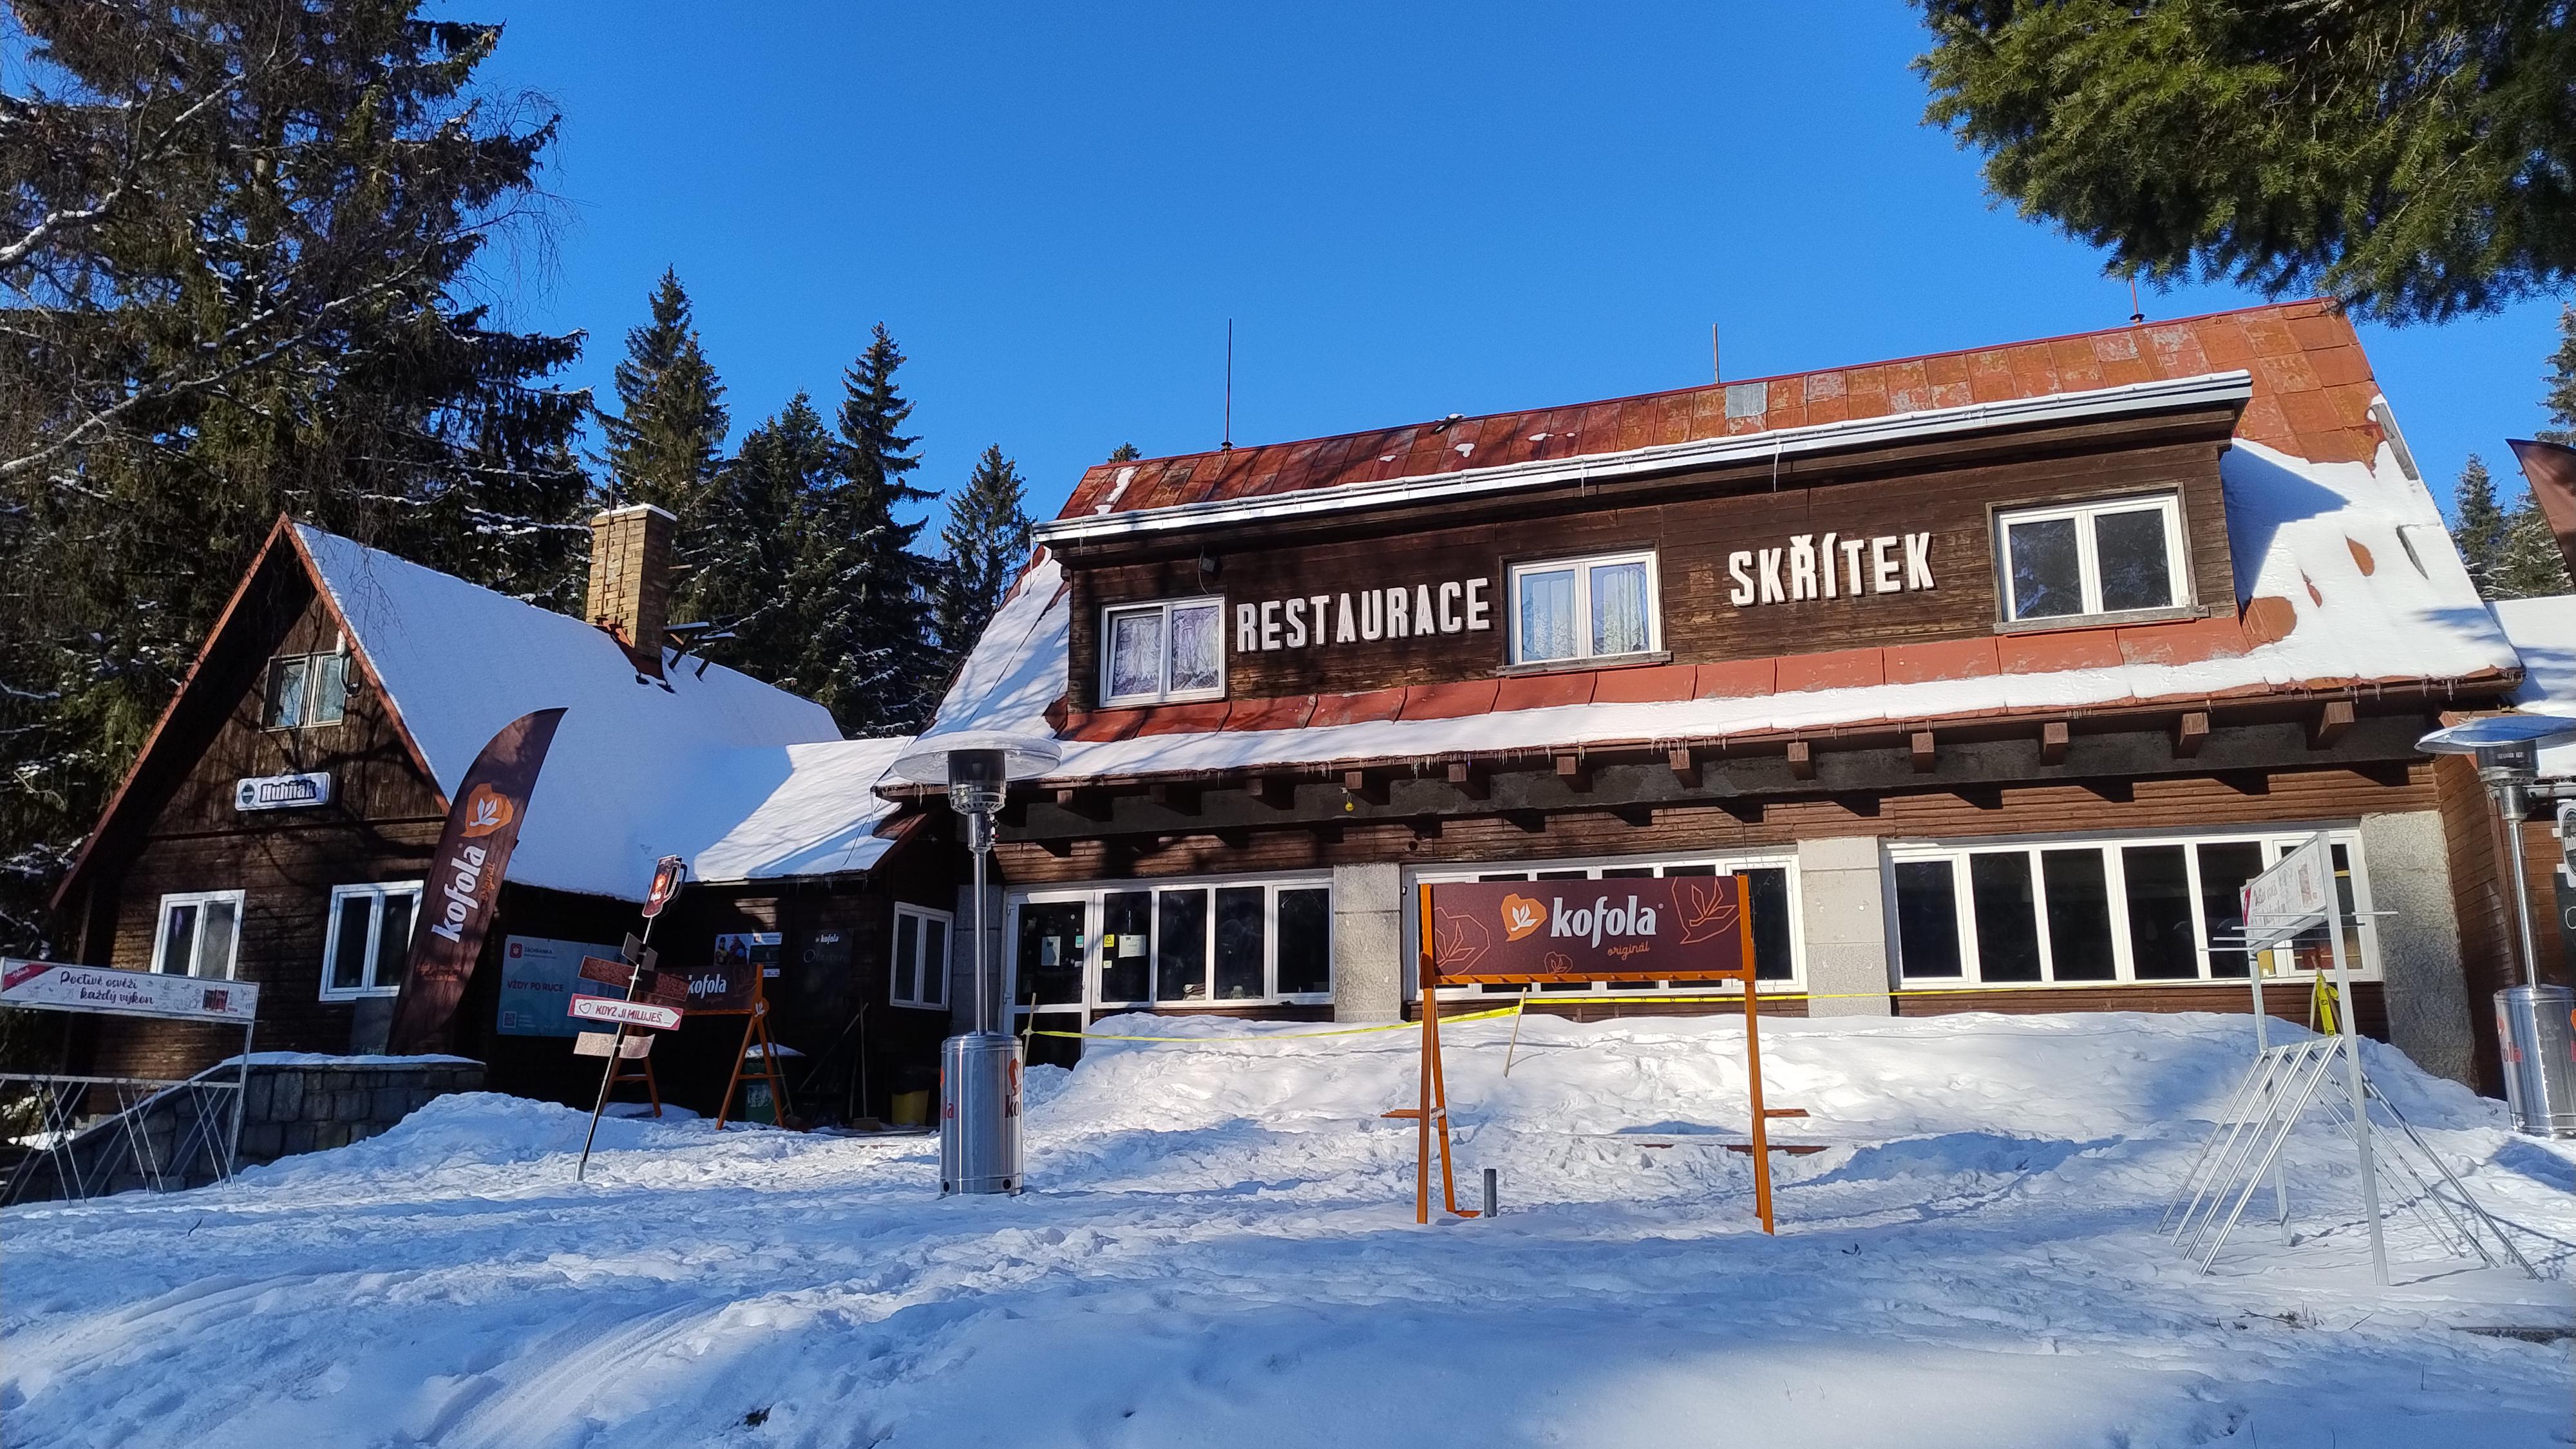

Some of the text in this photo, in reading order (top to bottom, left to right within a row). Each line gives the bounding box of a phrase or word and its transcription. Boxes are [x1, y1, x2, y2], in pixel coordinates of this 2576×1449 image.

[1728, 532, 1935, 607] SKŘÍTEK
[1236, 578, 1491, 652] RESTAURACE
[431, 845, 487, 943] kofola
[1550, 895, 1657, 949] kofola
[1607, 940, 1651, 961] originál
[60, 971, 138, 990] Poctivě osvěží
[507, 980, 564, 992] VŽDY PO RUCE
[80, 987, 155, 1005] každý výkon
[595, 1005, 618, 1017] KDYŽ
[2501, 1041, 2523, 1063] ola
